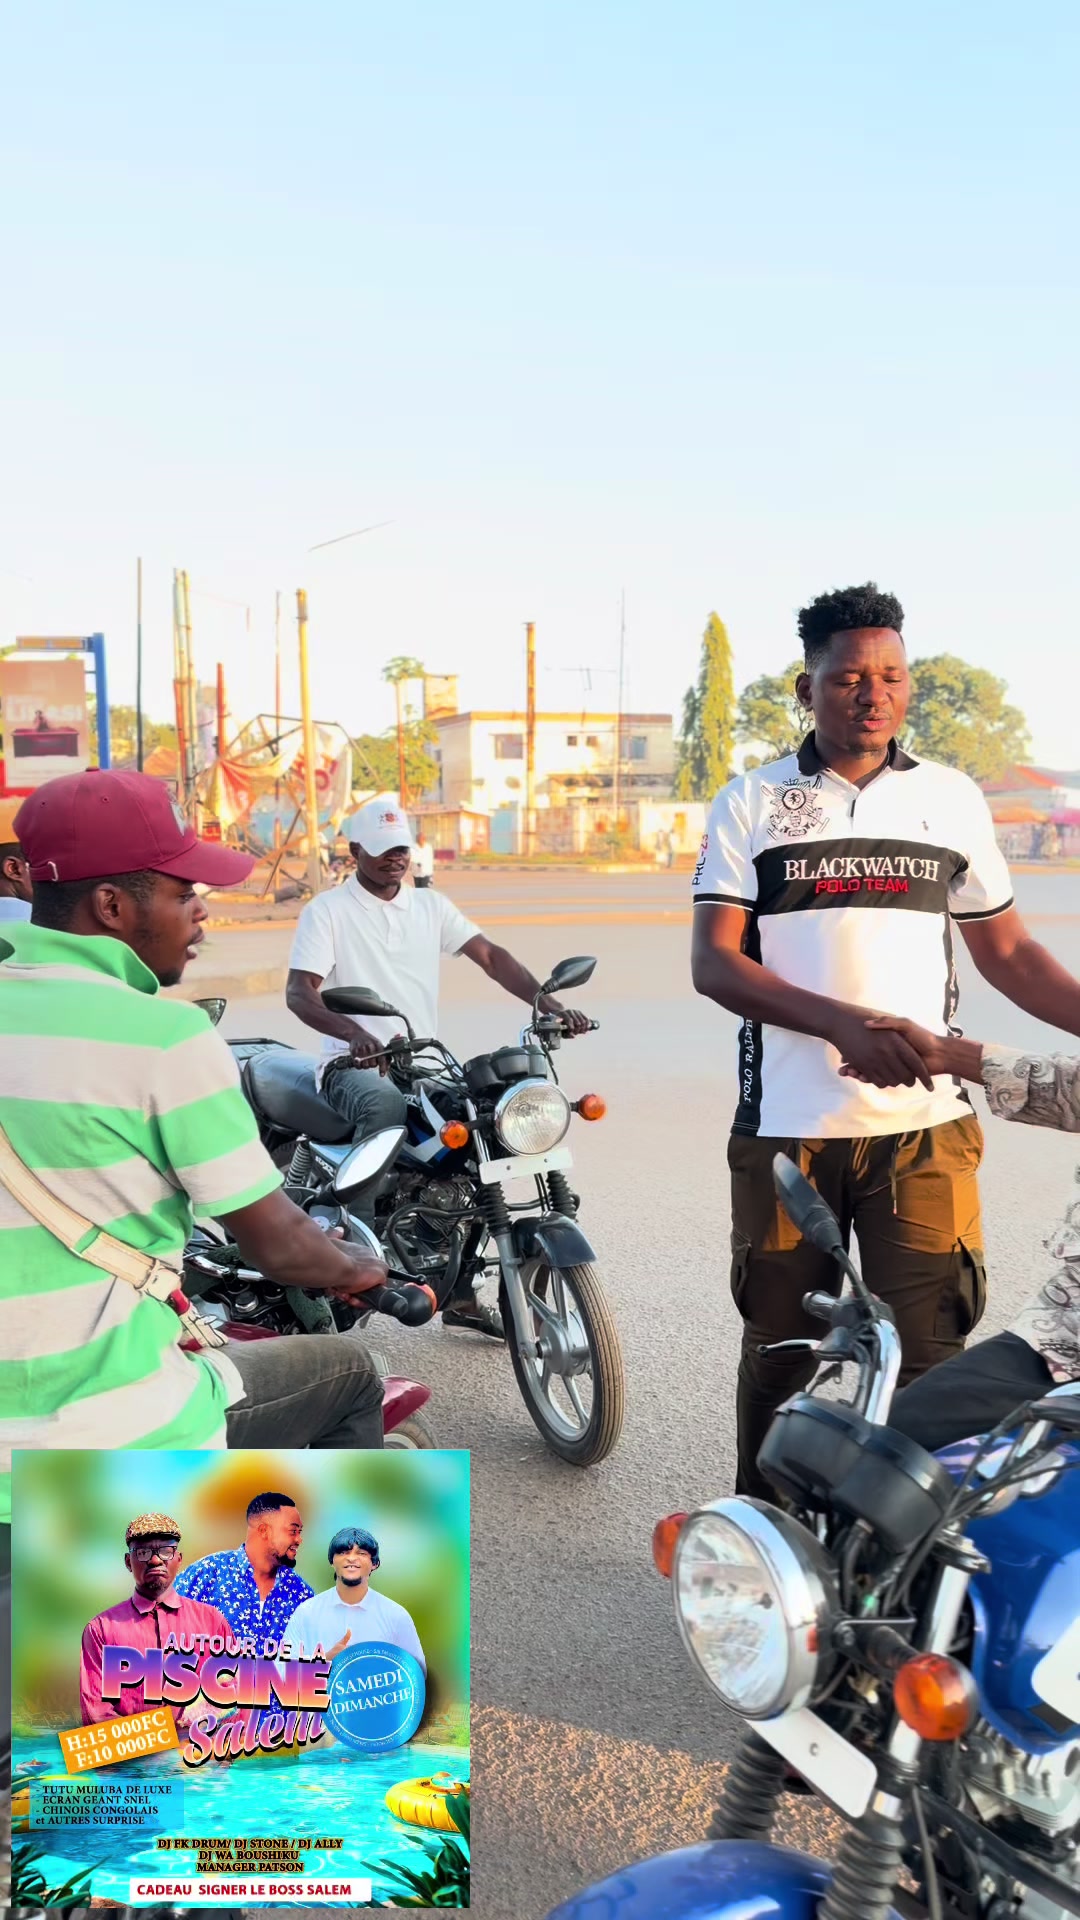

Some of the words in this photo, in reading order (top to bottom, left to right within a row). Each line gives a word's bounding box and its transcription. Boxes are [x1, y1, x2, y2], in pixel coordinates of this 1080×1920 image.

[784, 856, 941, 882] BLACKWATCH
[815, 879, 861, 895] POLO
[863, 878, 909, 893] TEAM
[743, 1069, 753, 1103] POLO
